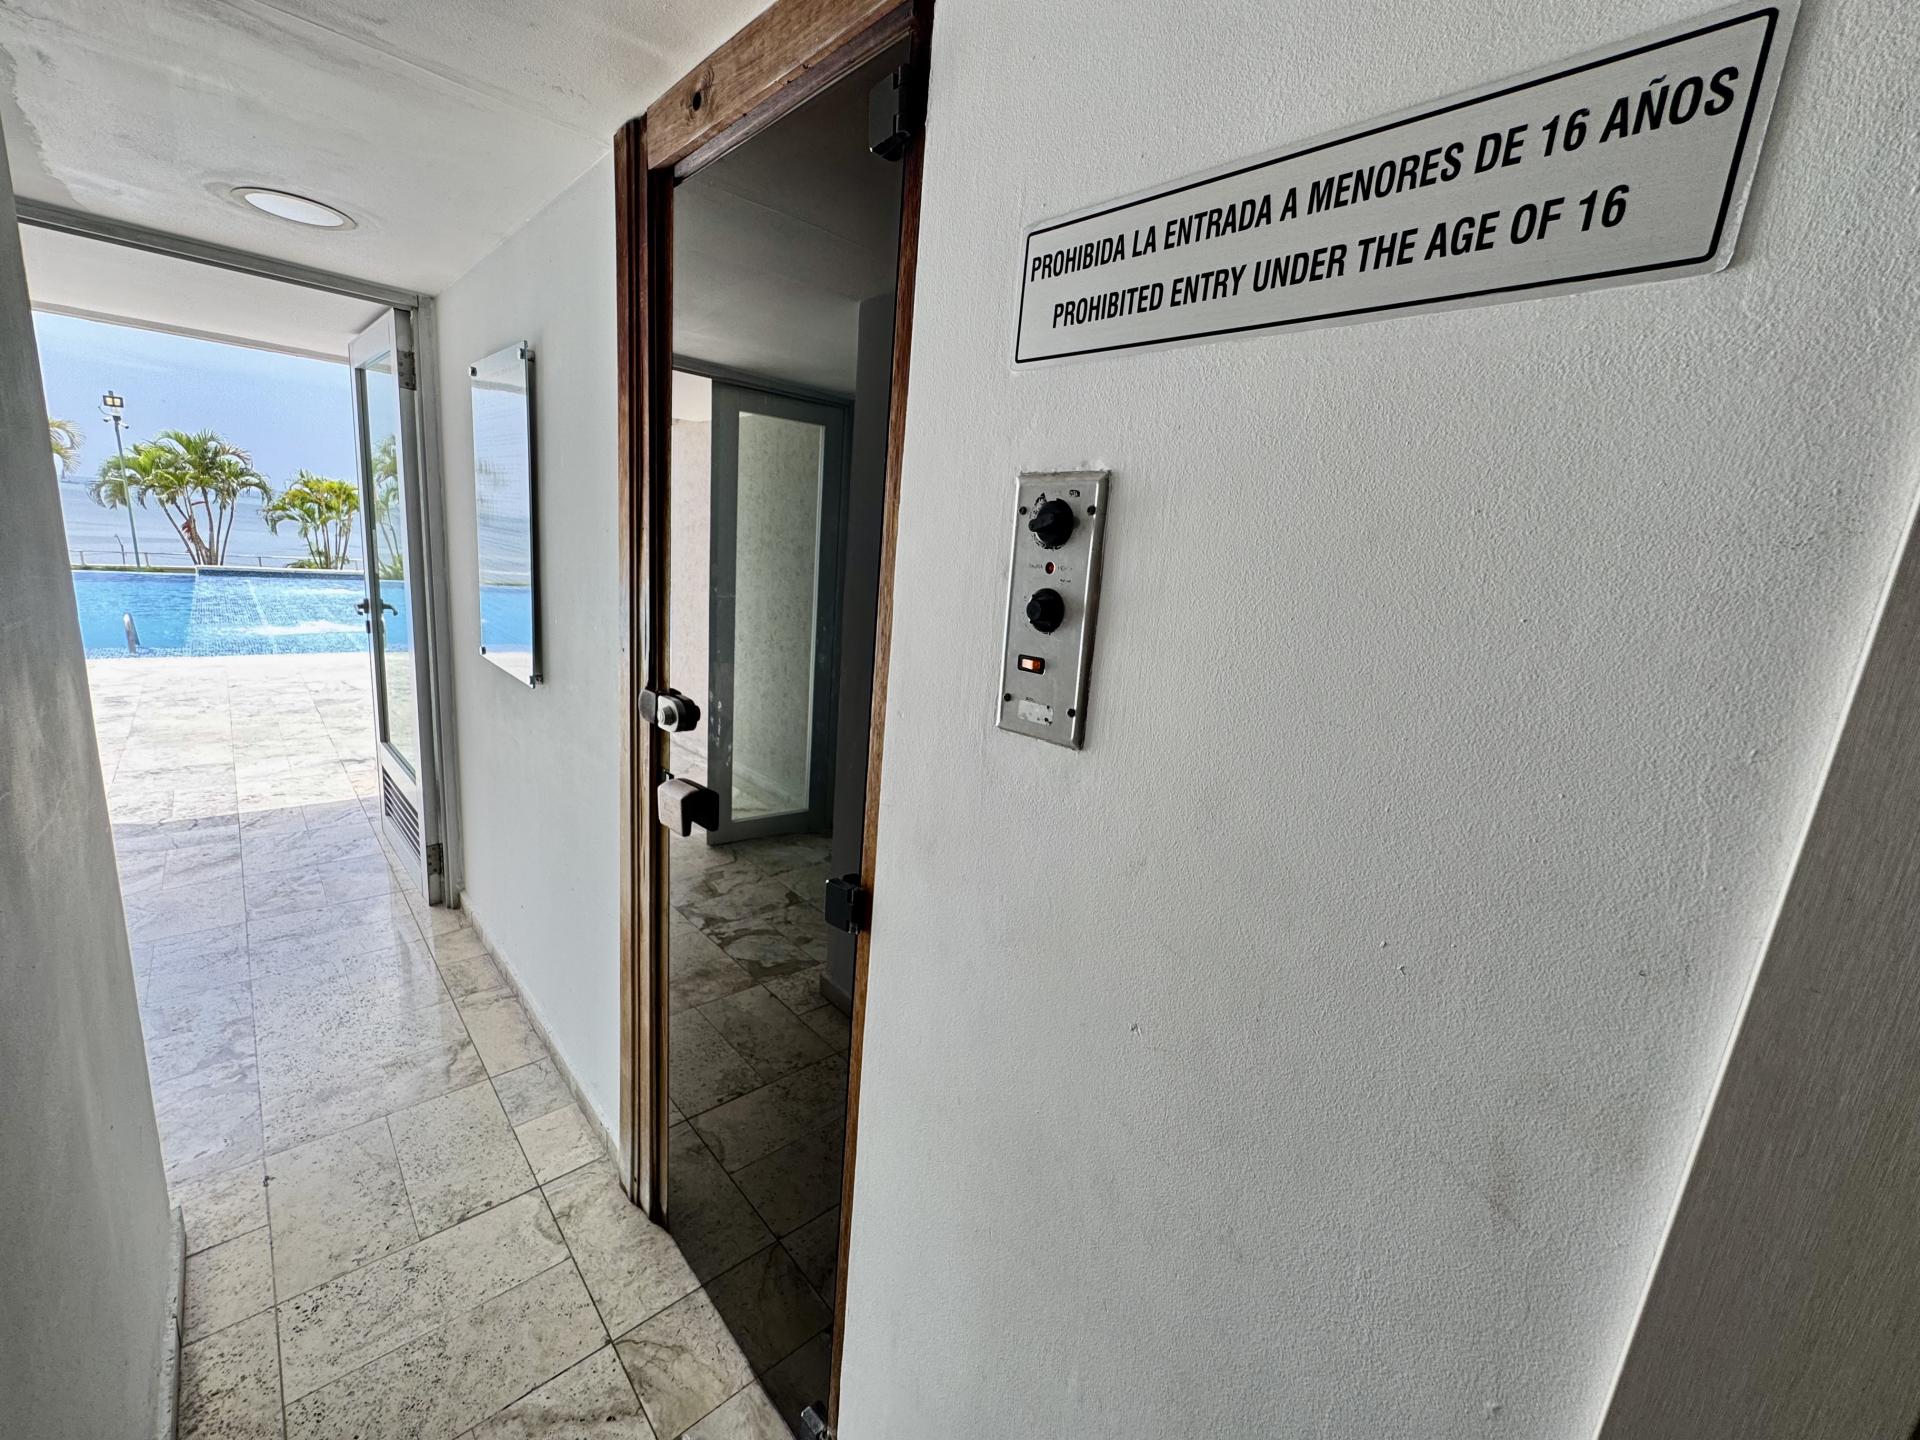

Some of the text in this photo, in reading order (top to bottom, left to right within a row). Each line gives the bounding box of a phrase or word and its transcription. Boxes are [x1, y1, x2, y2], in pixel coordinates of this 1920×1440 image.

[1031, 66, 1740, 283] PROHIBIDA LA ENTRADA A MENORES DE 16 AÑOS
[1053, 185, 1630, 329] PROHIBITED ENTRY UNDER THE AGE OF 16
